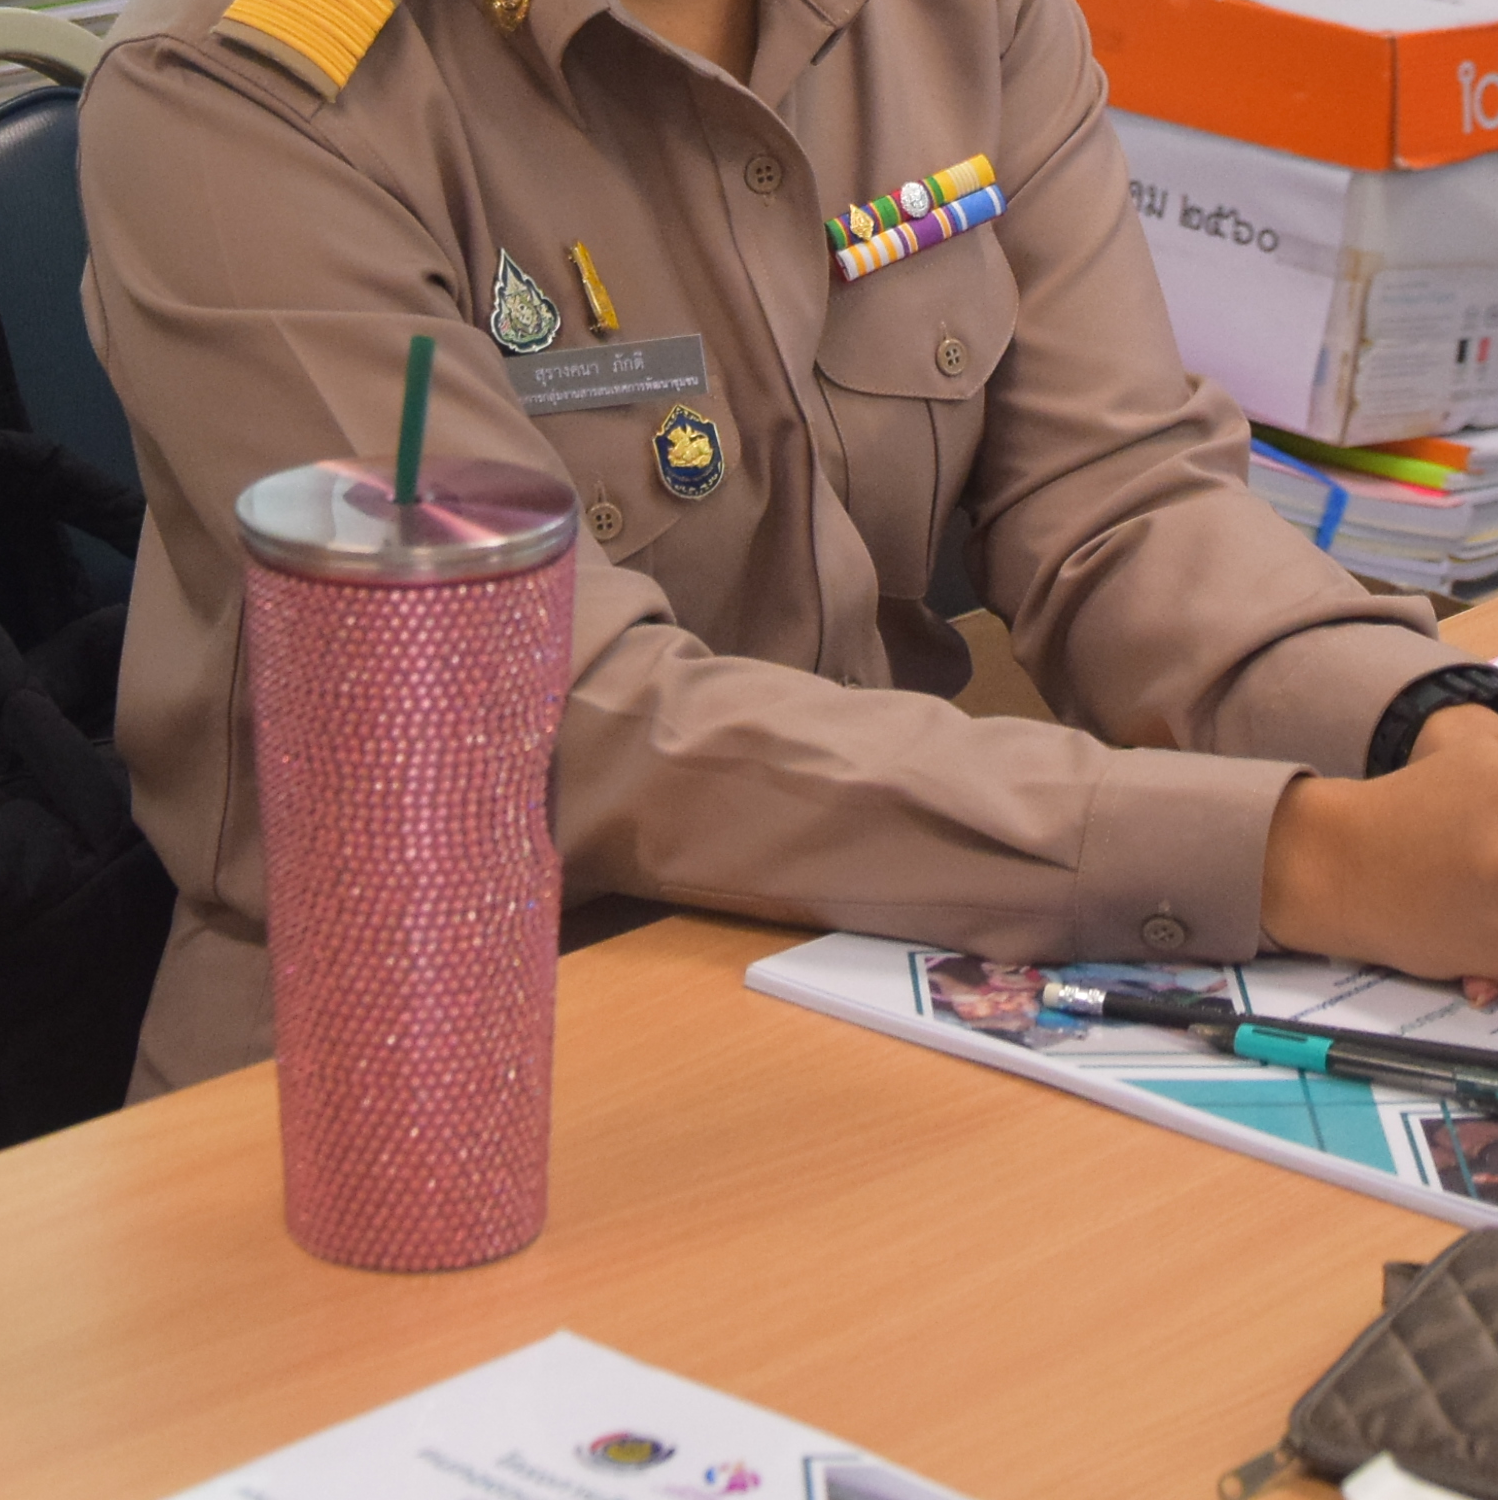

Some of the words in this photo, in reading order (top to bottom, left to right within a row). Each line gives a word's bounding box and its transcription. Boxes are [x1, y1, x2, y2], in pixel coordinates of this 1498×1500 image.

[534, 361, 600, 388] สุรางคนา
[612, 351, 646, 374] ภักดี
